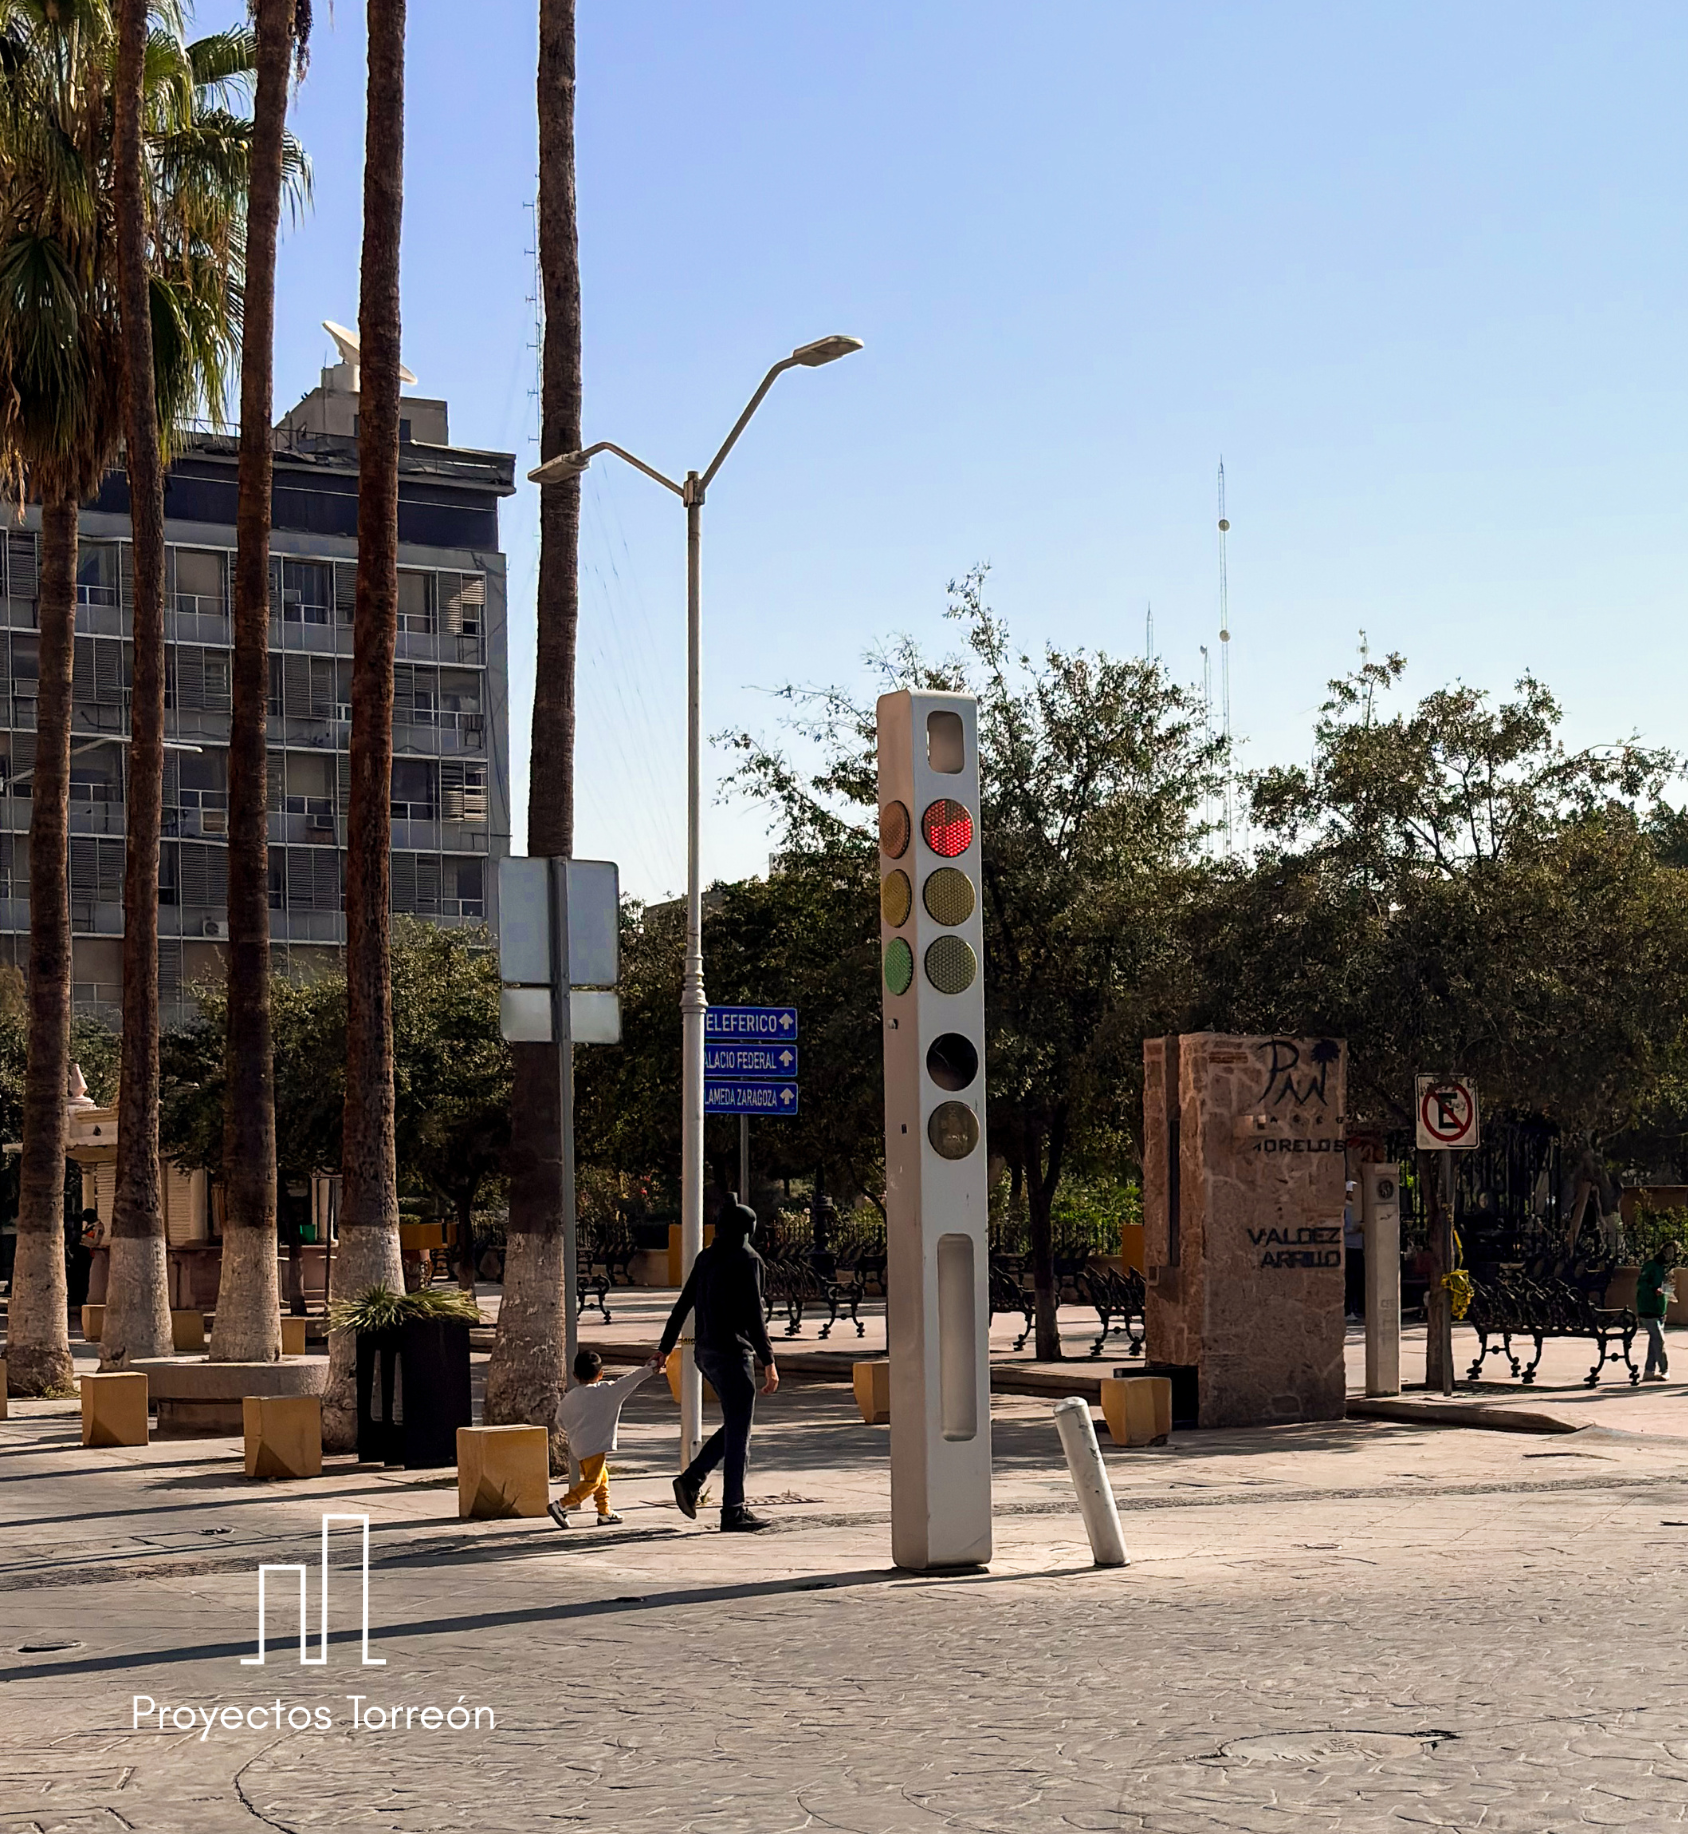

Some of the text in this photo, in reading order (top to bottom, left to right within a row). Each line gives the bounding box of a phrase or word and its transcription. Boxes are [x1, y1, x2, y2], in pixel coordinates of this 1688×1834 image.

[706, 1013, 777, 1032] ELEFERICO
[704, 1050, 777, 1069] ALACIO FEDERAL
[704, 1088, 777, 1107] LAMEDA ZARAGOZA
[1246, 1227, 1341, 1246] VALDEZ
